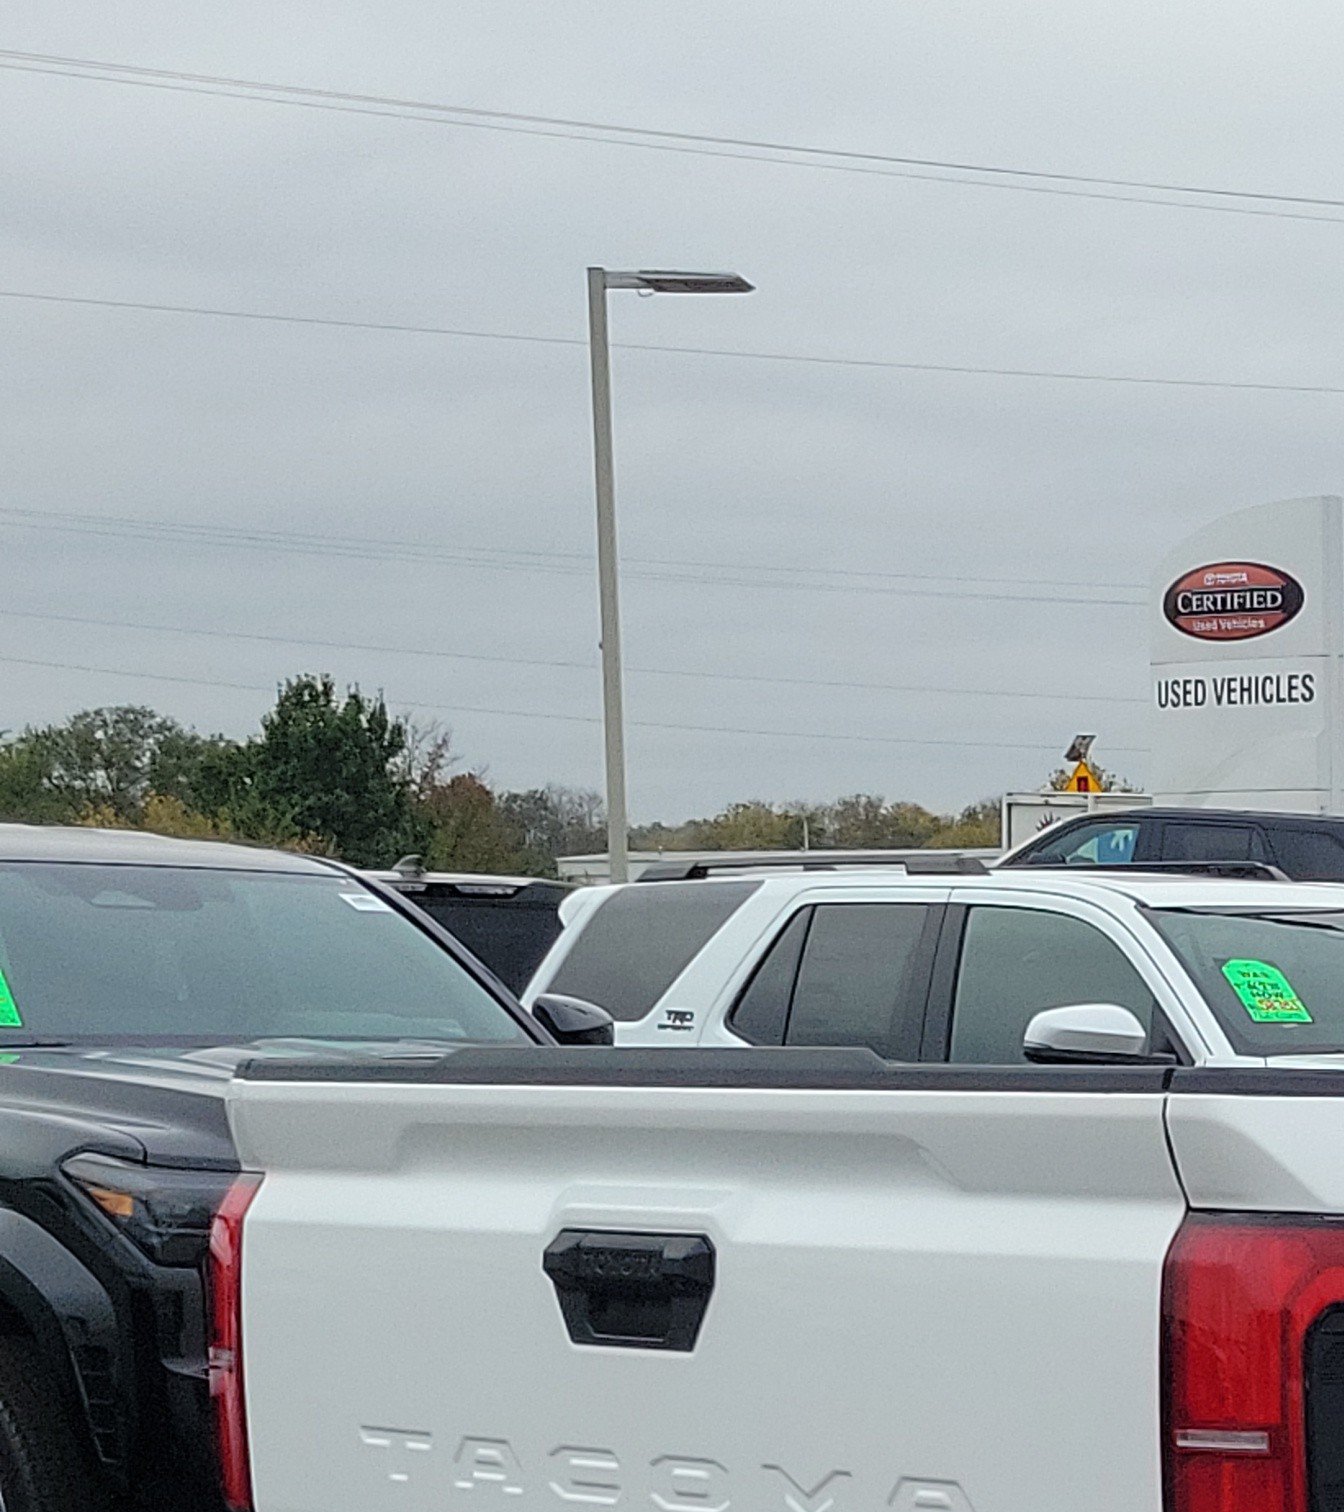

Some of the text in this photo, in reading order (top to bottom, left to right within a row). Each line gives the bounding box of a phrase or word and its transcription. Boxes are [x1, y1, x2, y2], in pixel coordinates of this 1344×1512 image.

[1176, 590, 1283, 614] CERTIFIED
[1157, 673, 1316, 708] USED VEHICLES
[665, 1009, 695, 1025] TRD
